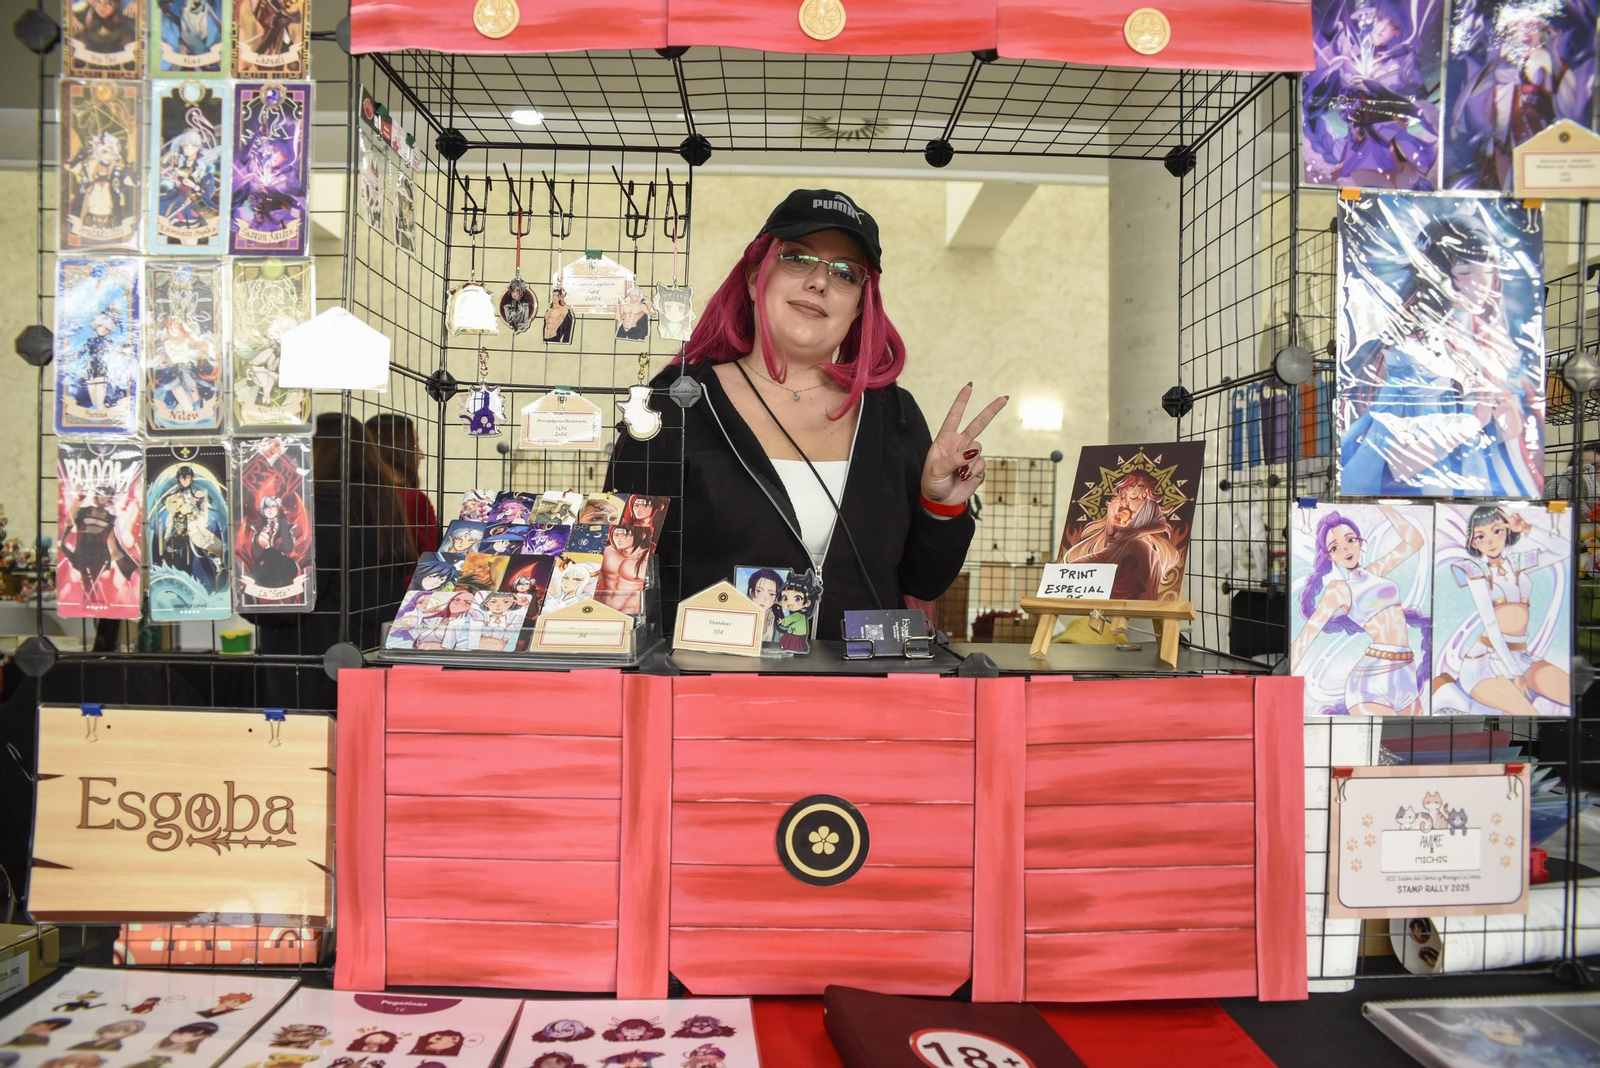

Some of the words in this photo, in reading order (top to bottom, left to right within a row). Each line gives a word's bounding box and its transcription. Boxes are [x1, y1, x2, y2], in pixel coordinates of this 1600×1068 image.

[812, 198, 856, 219] PUMA
[169, 410, 199, 420] Nilou
[1059, 568, 1098, 580] PRINT
[258, 589, 268, 597] La
[1044, 584, 1104, 594] ESPECIAL
[708, 619, 732, 627] Standees
[76, 777, 297, 852] Esgoba
[1420, 834, 1446, 848] ANIME
[1415, 855, 1448, 863] MICHIS
[1397, 885, 1423, 893] STAMP
[1425, 884, 1449, 893] RALLY
[1451, 883, 1470, 892] 2025
[922, 1042, 1021, 1068] 18+
